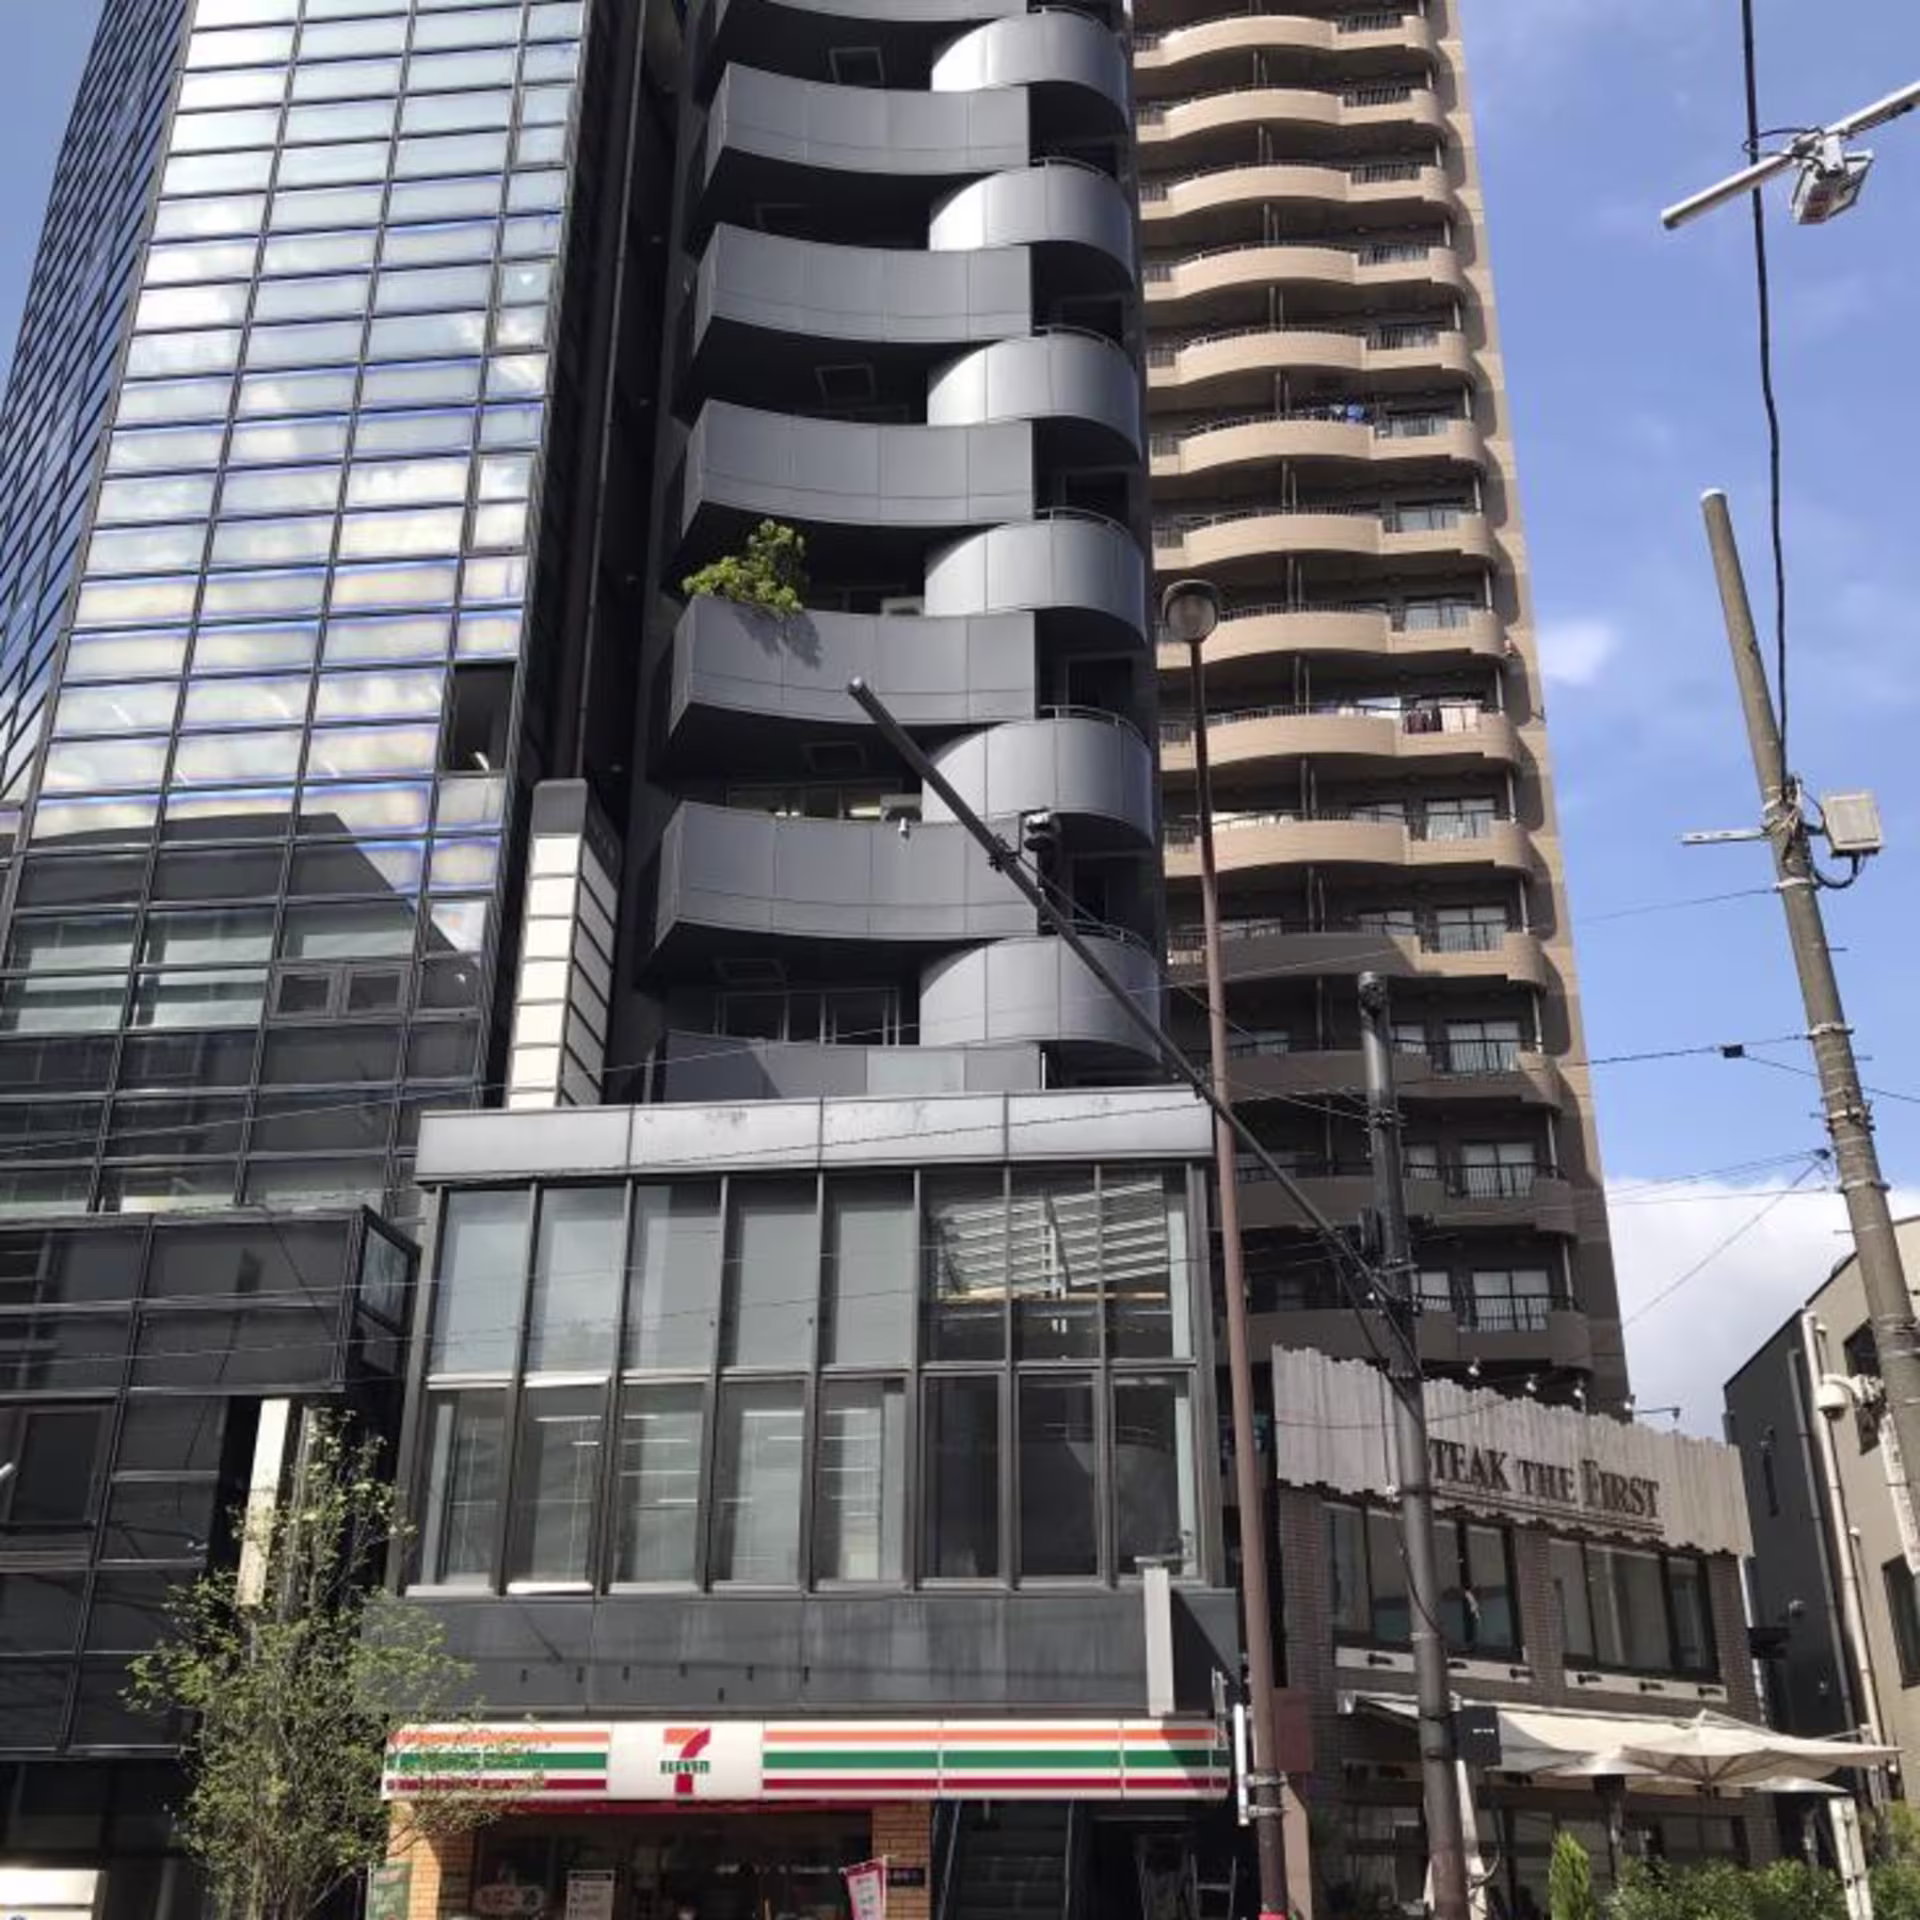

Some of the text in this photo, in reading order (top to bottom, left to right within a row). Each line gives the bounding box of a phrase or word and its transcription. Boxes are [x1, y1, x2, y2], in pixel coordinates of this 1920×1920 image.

[1426, 1438, 1660, 1517] TEAK THE FIRST
[664, 1728, 711, 1794] 7
